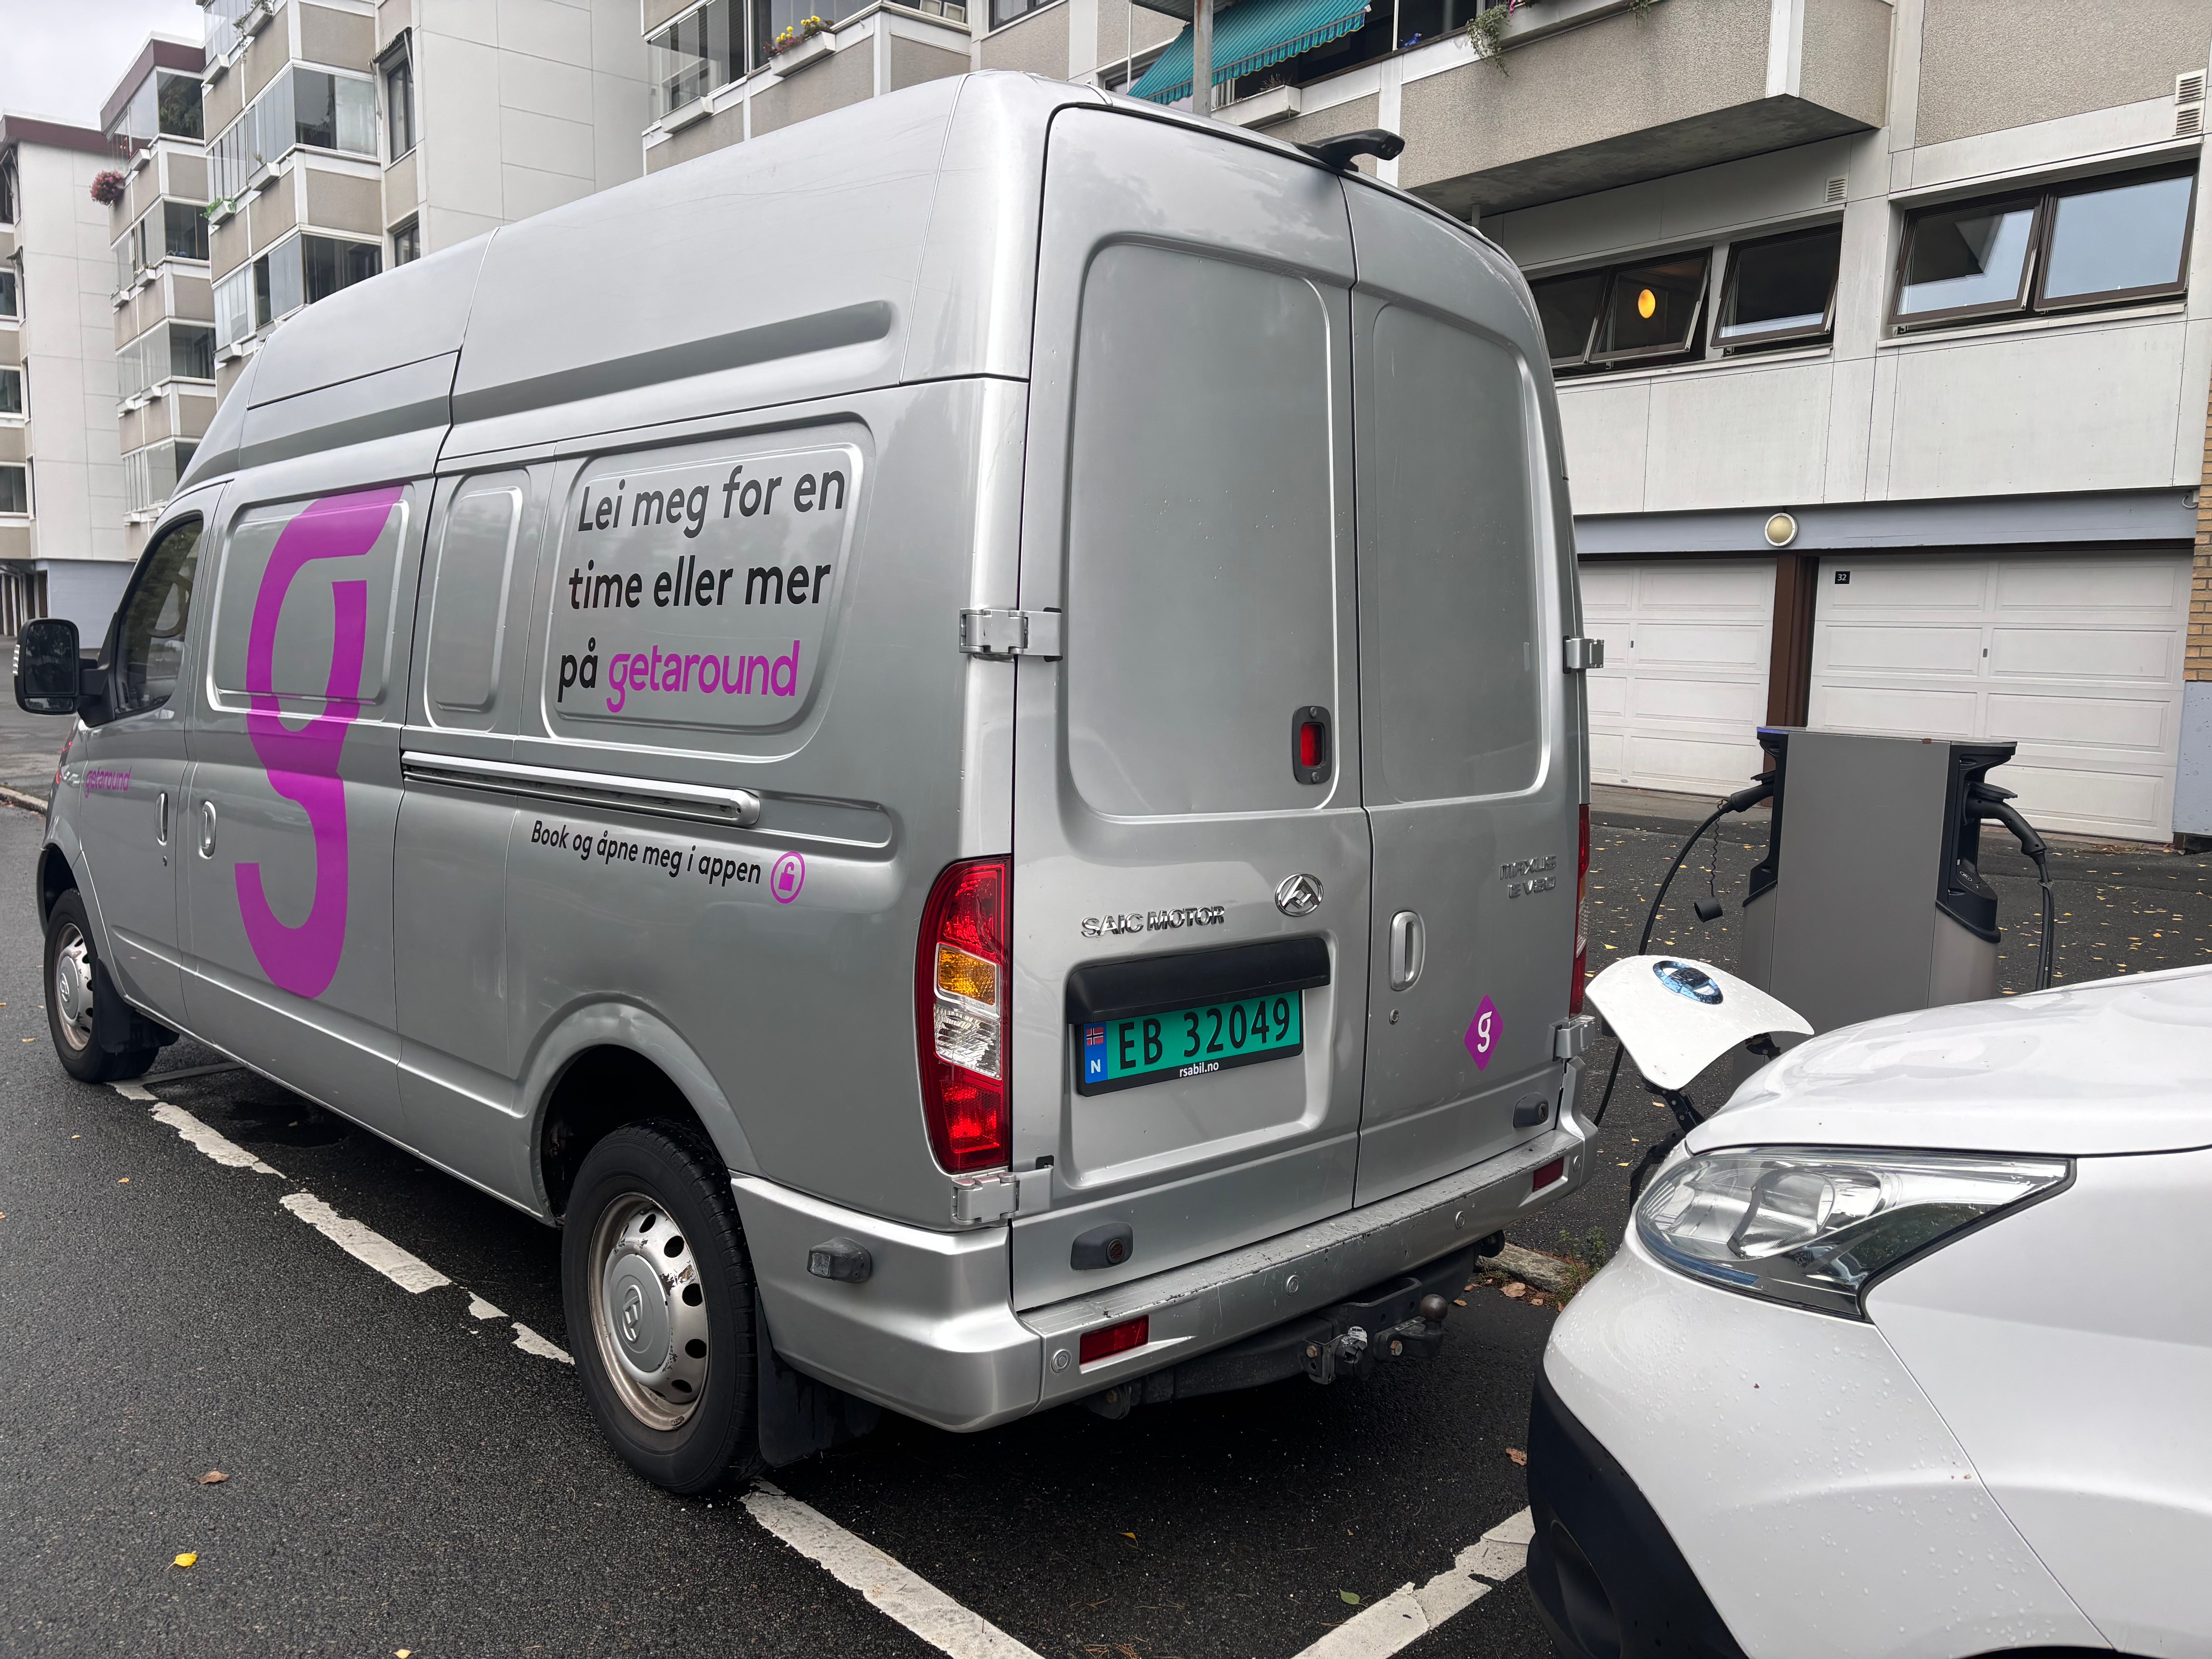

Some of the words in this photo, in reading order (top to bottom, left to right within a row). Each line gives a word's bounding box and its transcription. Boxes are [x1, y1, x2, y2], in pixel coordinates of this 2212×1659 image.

[578, 479, 626, 532] Lei
[631, 484, 709, 538] meg
[722, 465, 782, 519] for
[793, 470, 845, 513] en
[568, 560, 642, 610] time
[653, 555, 733, 606] eller
[745, 564, 831, 605] mer
[557, 637, 598, 703] på
[606, 640, 800, 713] getaround
[84, 766, 132, 799] getaround
[531, 820, 569, 849] Book
[573, 835, 593, 860] og
[596, 830, 638, 865] åpne
[642, 846, 683, 878] meg
[687, 845, 696, 871] i
[698, 856, 761, 887] appen
[1500, 855, 1556, 880] MAXUS
[1081, 913, 1144, 938] SAIC
[1147, 905, 1225, 931] MOTOR
[1119, 1018, 1163, 1070] EB
[1183, 997, 1290, 1057] 32049
[1477, 1011, 1492, 1053] g
[1091, 1059, 1101, 1073] N
[1179, 1061, 1219, 1077] rsabil.no
